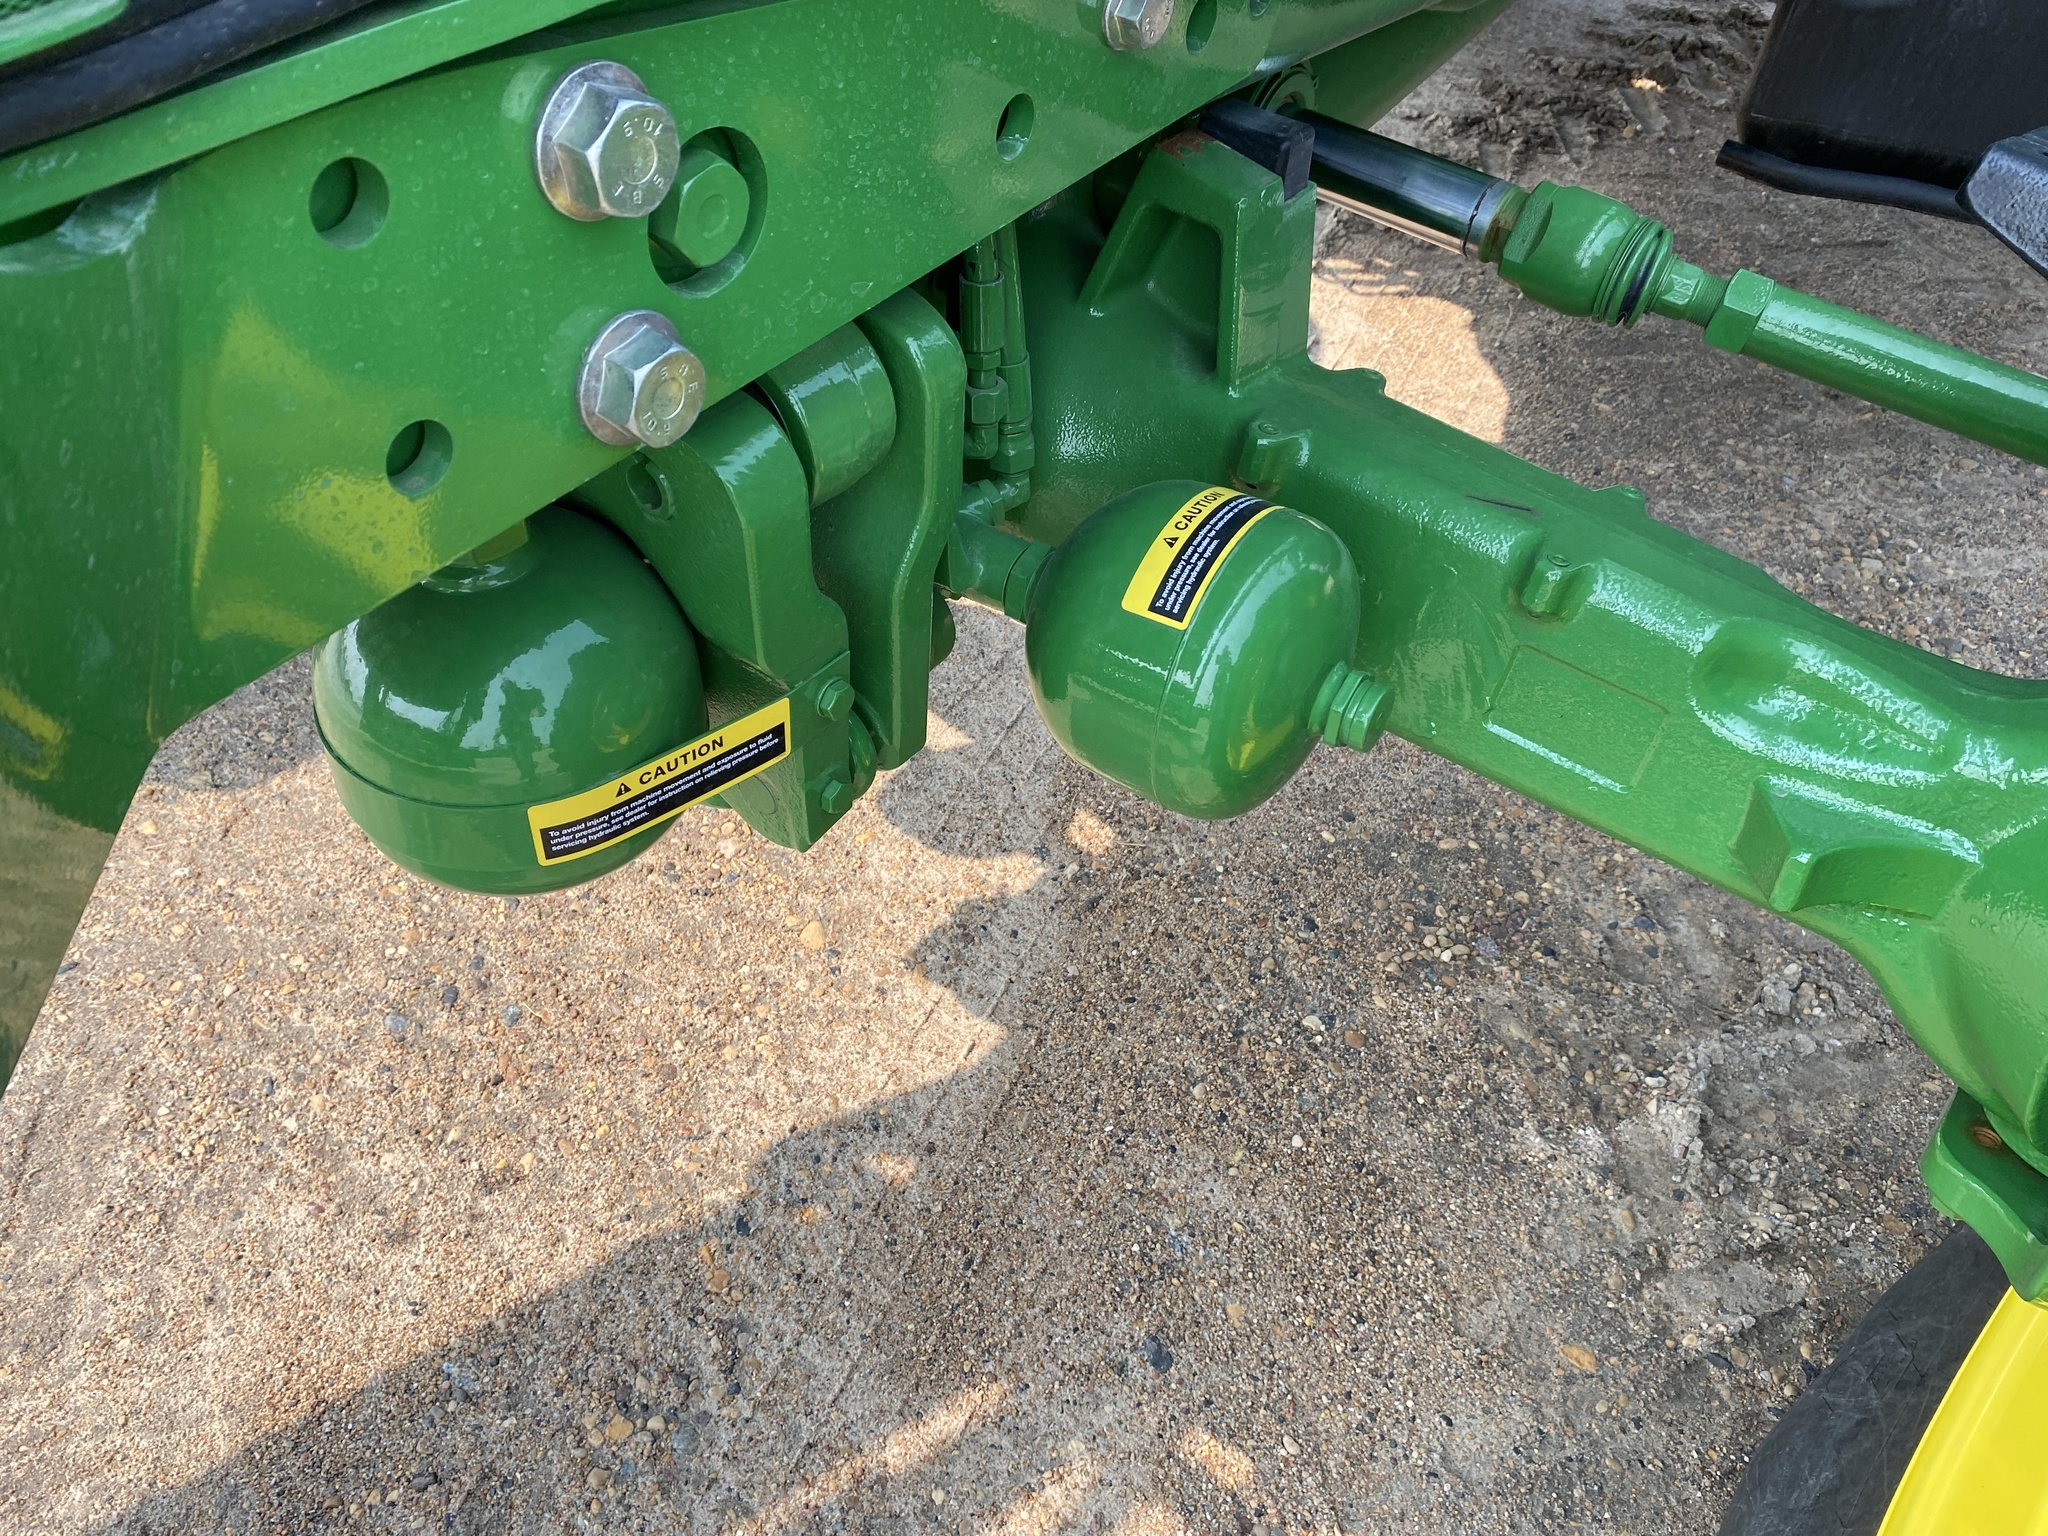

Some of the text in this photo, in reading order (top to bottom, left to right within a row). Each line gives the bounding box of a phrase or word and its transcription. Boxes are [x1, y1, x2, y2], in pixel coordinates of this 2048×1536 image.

[1174, 490, 1225, 531] CAUTION
[1155, 598, 1165, 607] To
[1161, 579, 1175, 599] avoid
[1170, 560, 1187, 581] injury
[1181, 545, 1195, 561] from
[1192, 524, 1212, 546] machine
[1164, 590, 1177, 611] under
[1174, 564, 1194, 592] pressure,
[1189, 552, 1200, 564] see
[1197, 537, 1210, 553] dealer
[1207, 529, 1217, 539] for
[1172, 538, 1221, 614] servicing hydraulic system.
[548, 830, 560, 838] To
[561, 822, 586, 835] avoid
[586, 814, 609, 827] injury
[610, 805, 630, 818] from
[630, 789, 662, 808] machine
[663, 770, 702, 792] movement
[702, 762, 716, 773] and
[716, 746, 748, 766] exposure
[757, 733, 773, 745] fluid
[550, 834, 574, 845] under
[575, 821, 611, 839] pressure,
[611, 815, 624, 825] see
[625, 804, 647, 818] dealer
[647, 799, 658, 808] for
[658, 781, 695, 802] instruction
[694, 776, 704, 785] on
[704, 762, 732, 780] relieving
[732, 749, 759, 766] pressure
[759, 738, 779, 752] before
[639, 735, 725, 785] CAUTION
[551, 812, 650, 852] servicing hydraulic system.
